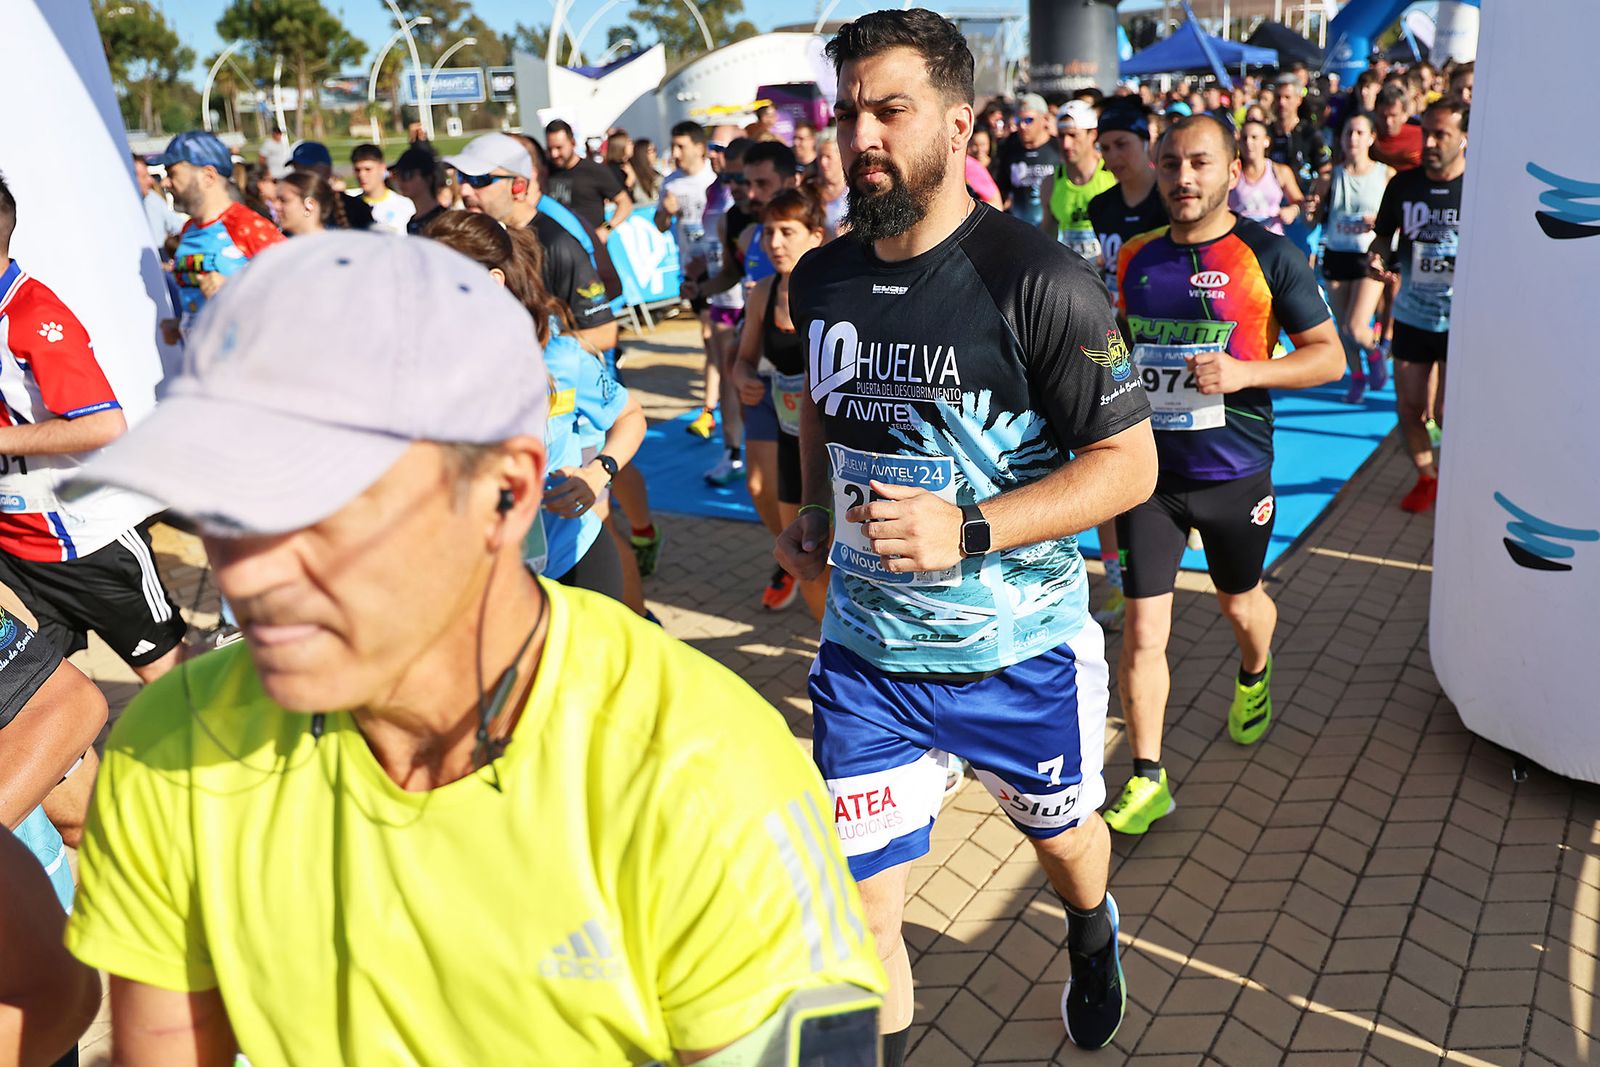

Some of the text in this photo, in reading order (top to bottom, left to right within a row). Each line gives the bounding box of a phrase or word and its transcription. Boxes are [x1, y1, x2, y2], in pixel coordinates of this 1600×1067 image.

[1196, 274, 1223, 285] KIA
[1188, 289, 1226, 299] VEYSER
[856, 341, 961, 386] HUELVA
[856, 382, 962, 401] PUERTA DEL DESCUBRIMIENTO
[845, 400, 919, 423] AVATEL
[845, 457, 868, 472] HUELVA
[870, 464, 914, 479] AVATEL
[1037, 753, 1064, 788] 7
[834, 785, 897, 823] ATEA
[837, 810, 904, 840] LUCIONES
